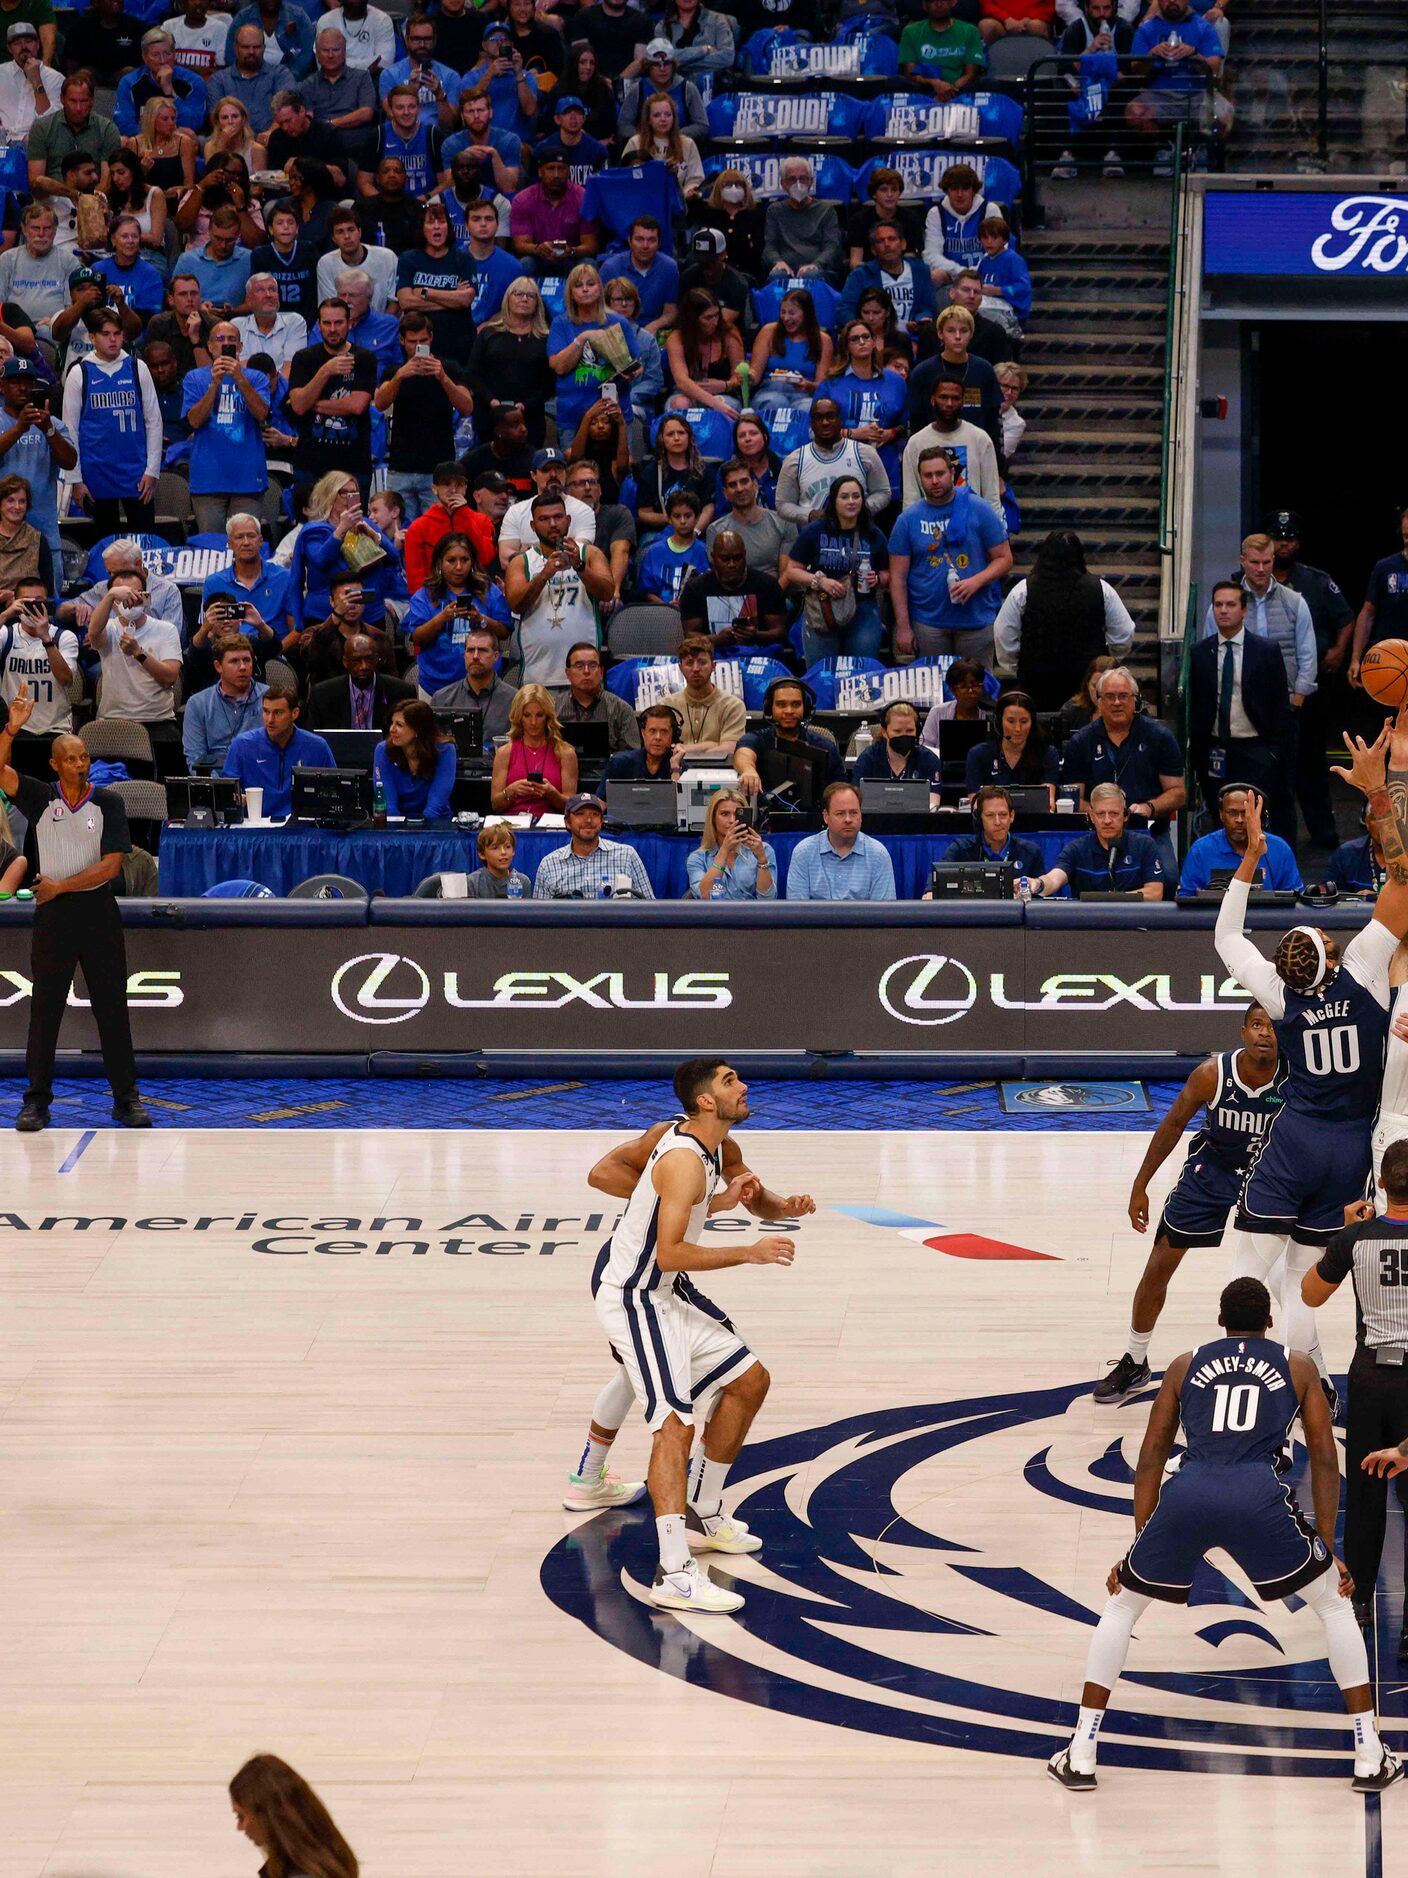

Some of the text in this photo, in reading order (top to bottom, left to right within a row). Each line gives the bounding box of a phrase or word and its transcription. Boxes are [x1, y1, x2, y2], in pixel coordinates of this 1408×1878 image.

[801, 45, 860, 75] LOUD!
[766, 99, 828, 132] LOUD!
[919, 103, 978, 137] LOUD!
[279, 284, 301, 303] 12
[90, 390, 136, 409] DALLAS
[112, 409, 137, 433] 77
[142, 550, 162, 564] ET'S
[553, 586, 580, 609] 77
[9, 656, 51, 674] DALLAS
[639, 665, 666, 685] LET'S
[28, 680, 53, 704] 77
[840, 673, 866, 692] LET'S
[874, 665, 942, 701] LOUD!
[444, 971, 733, 1009] LEXUS
[1302, 1000, 1350, 1027] McGEE
[1302, 1024, 1361, 1076] 00
[444, 1212, 802, 1232] Airlies
[251, 1235, 580, 1256] Center
[1190, 1355, 1287, 1392] FINNEY-SMITH
[1211, 1383, 1261, 1433] 10
